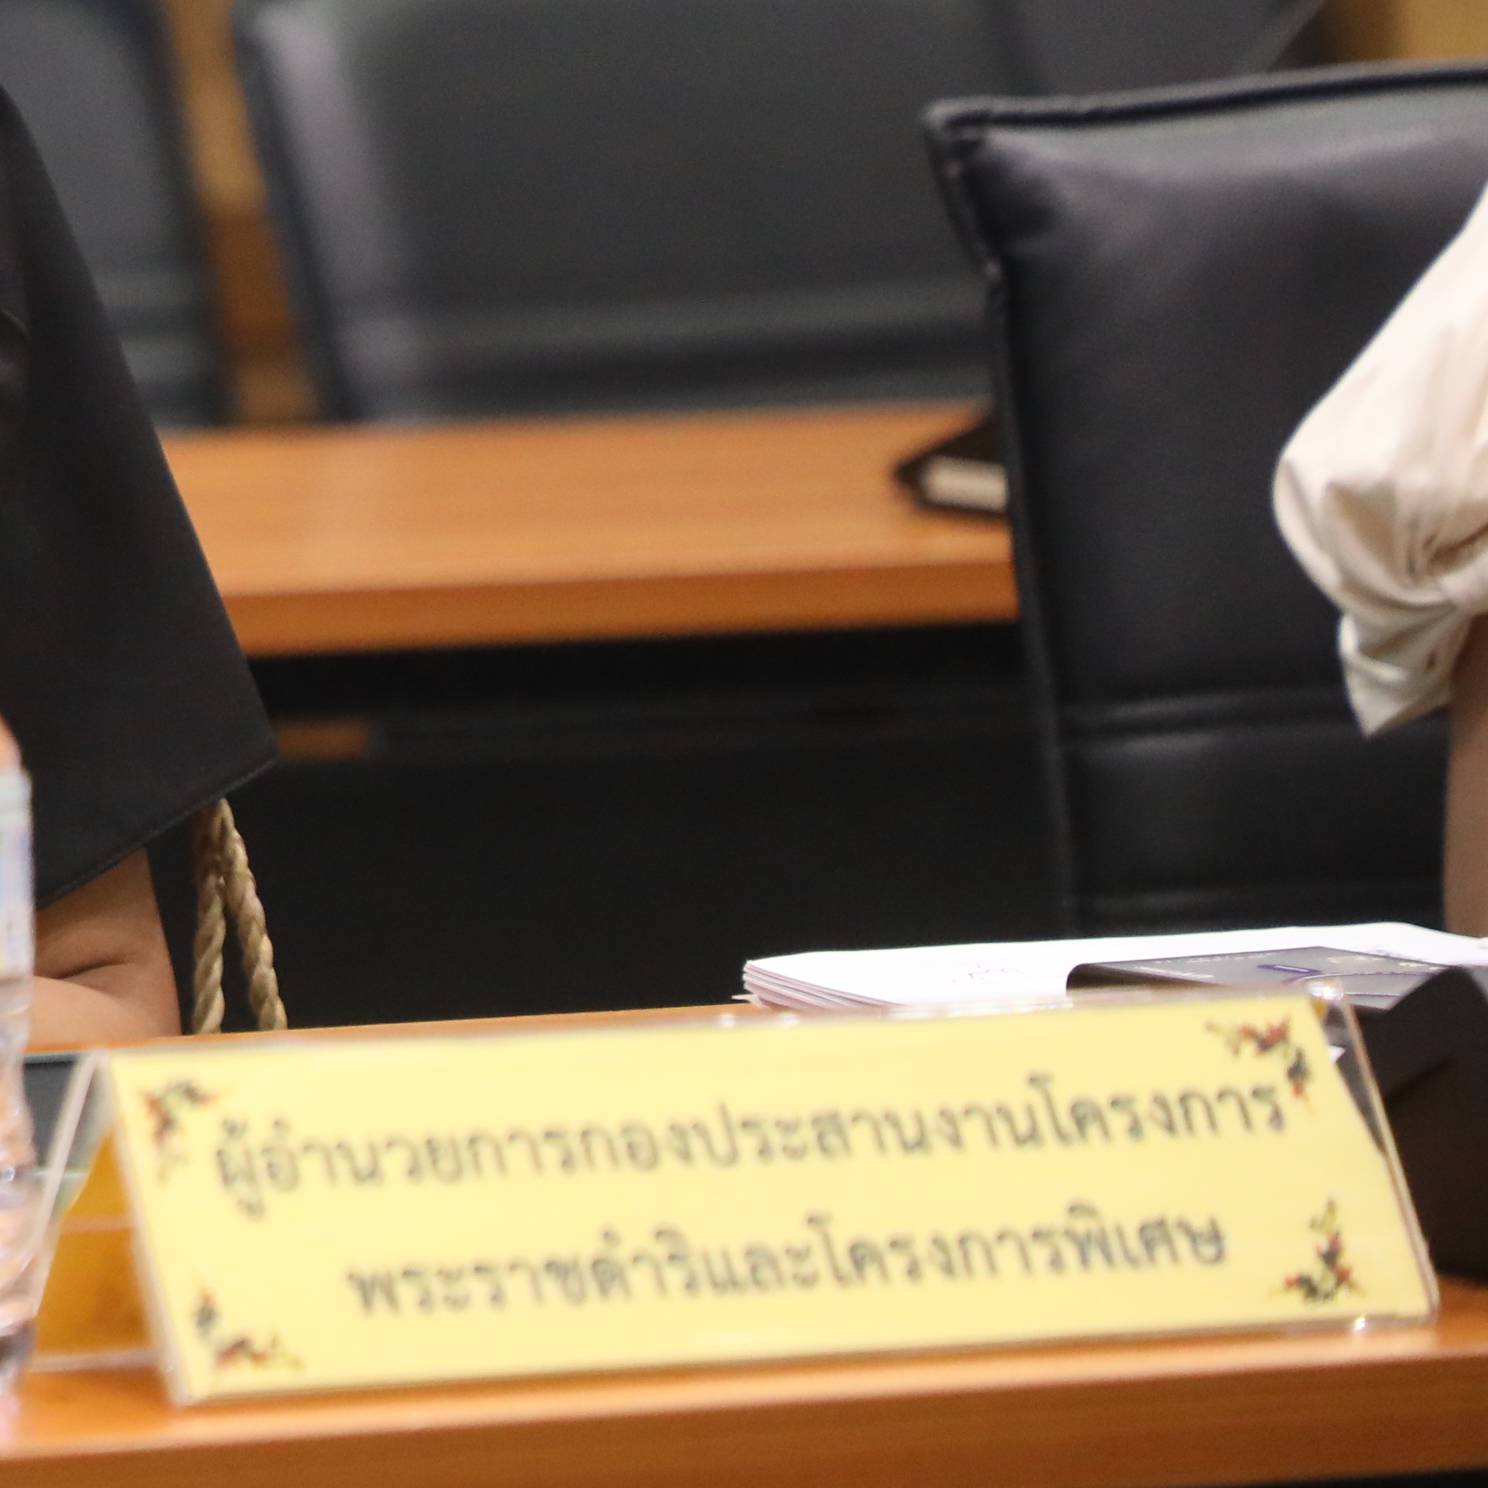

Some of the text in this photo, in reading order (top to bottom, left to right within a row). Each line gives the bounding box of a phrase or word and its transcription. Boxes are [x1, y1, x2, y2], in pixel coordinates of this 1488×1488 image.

[215, 1073, 1286, 1220] ผู้อำนวยการกองประสานงานโครงการ
[346, 1199, 1226, 1315] พระราชดำริและโครงการพิเศษ
